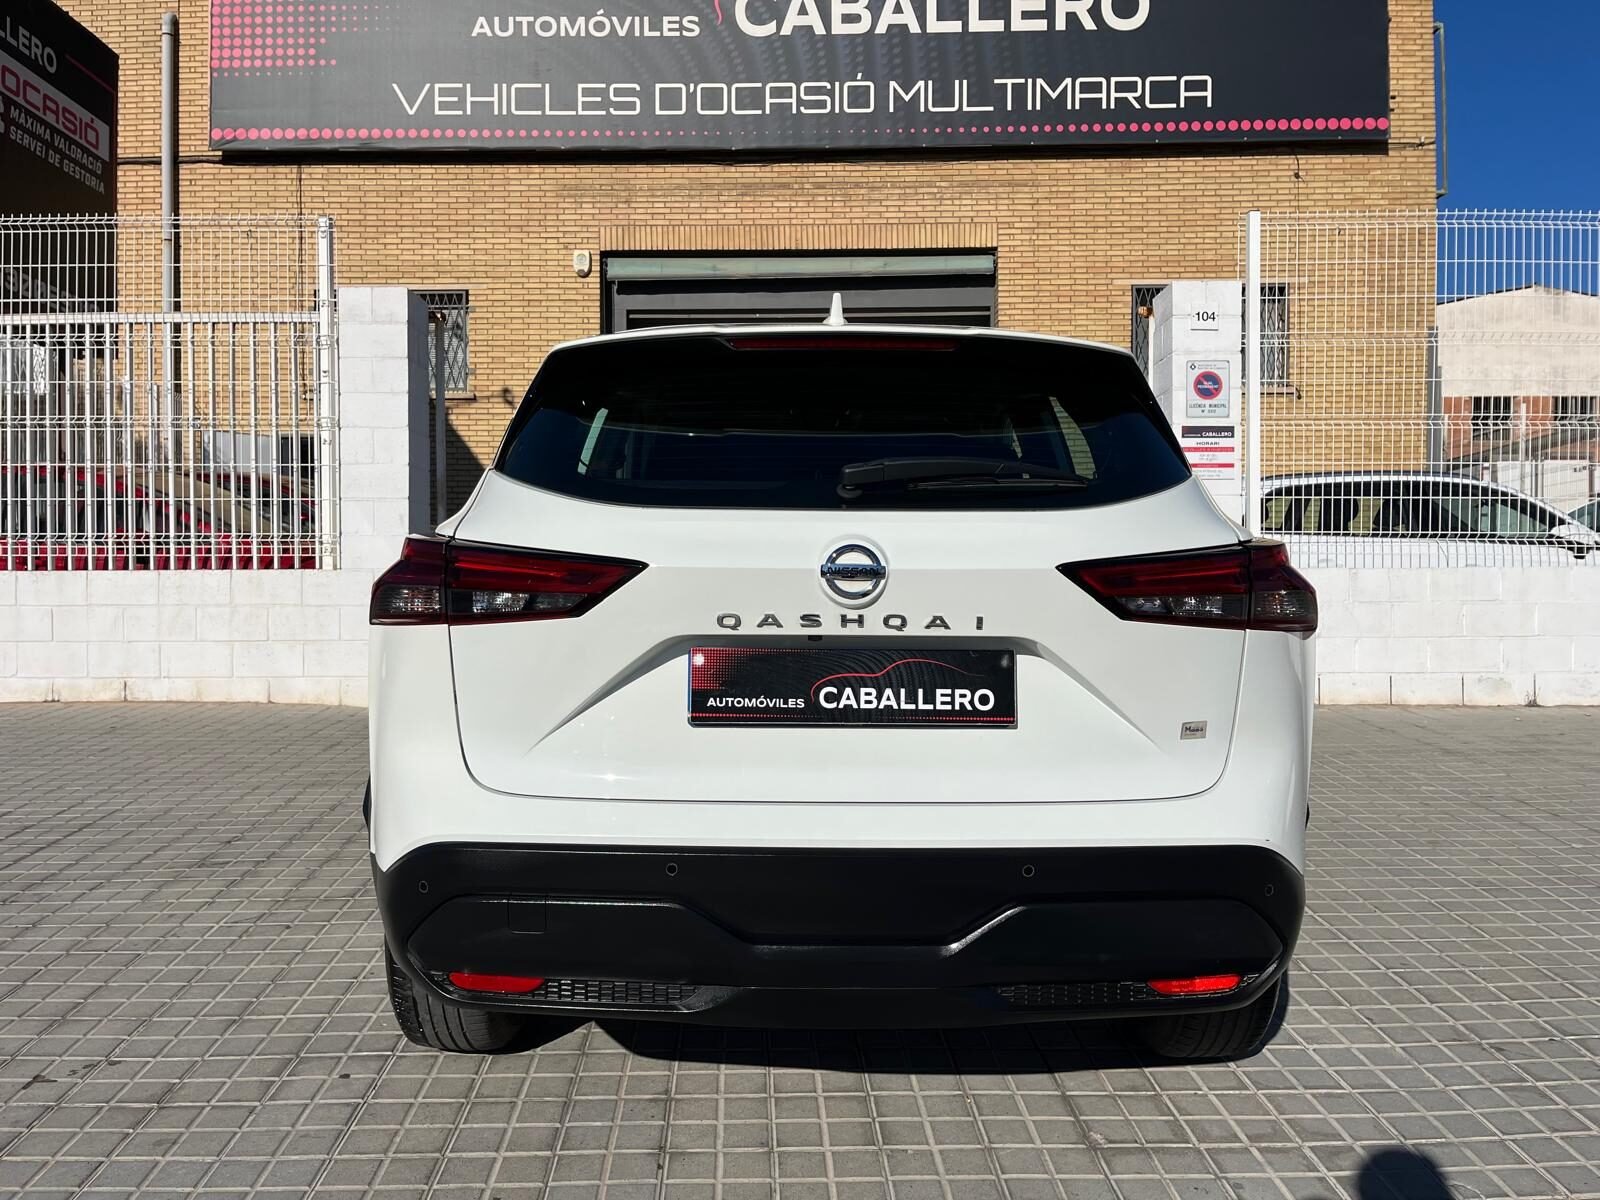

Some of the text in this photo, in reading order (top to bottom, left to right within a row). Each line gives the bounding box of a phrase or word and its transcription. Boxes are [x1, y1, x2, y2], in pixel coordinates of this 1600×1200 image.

[471, 0, 1150, 38] AUTOMÓVILES CABALLERO
[1, 64, 100, 151] OCASIÓ
[392, 73, 1212, 116] VEHICLES D'OCASIÓ MULTIMARCA
[9, 126, 105, 195] SERVEI DE GESTORIA
[1195, 311, 1216, 322] 104
[716, 612, 984, 632] QASHQAI
[706, 686, 995, 711] AUTOMÓVILES CABALLERO
